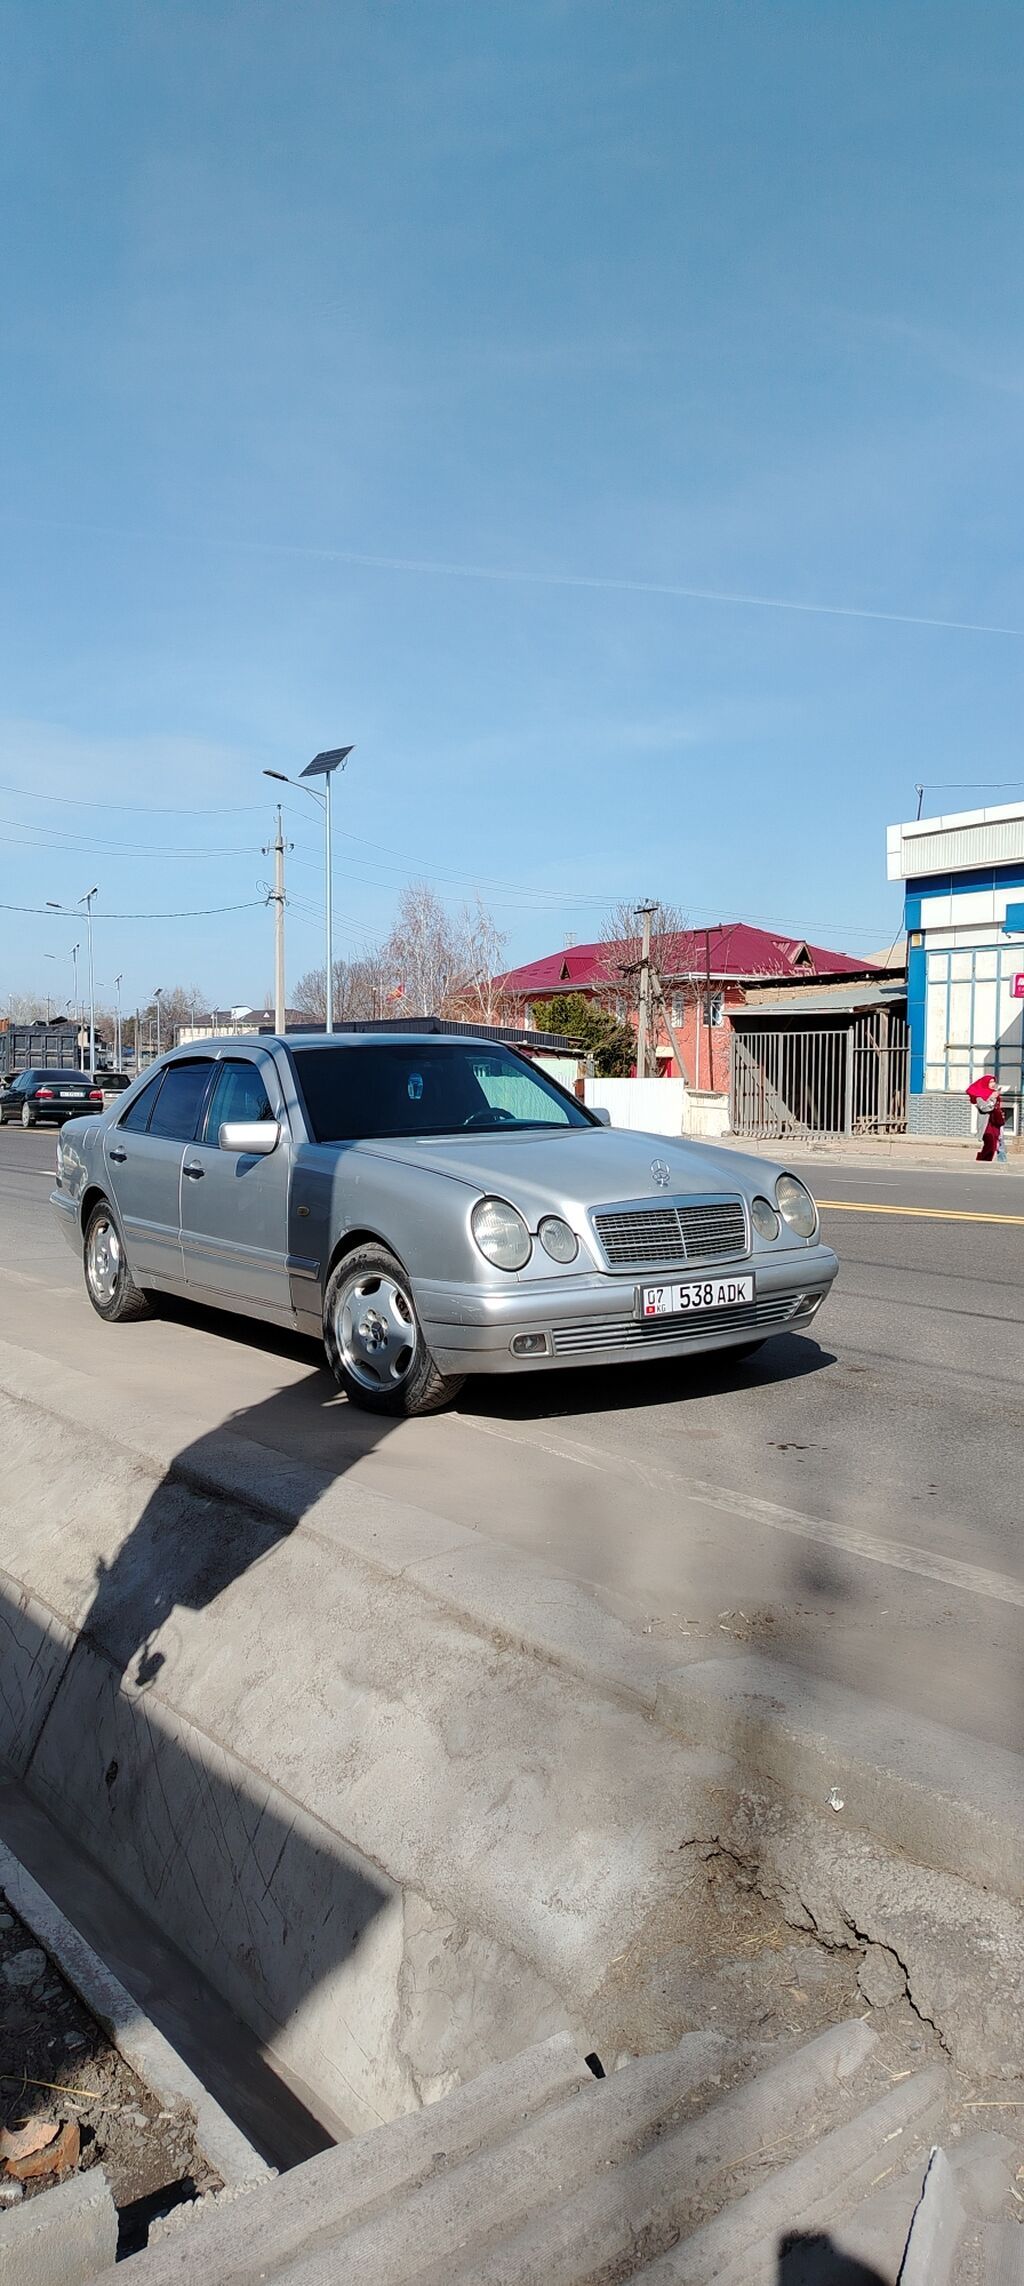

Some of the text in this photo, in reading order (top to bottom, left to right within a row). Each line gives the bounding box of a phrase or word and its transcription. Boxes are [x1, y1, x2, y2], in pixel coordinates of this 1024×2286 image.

[647, 1282, 746, 1309] 07 538 ADK
[656, 1304, 666, 1313] KG
